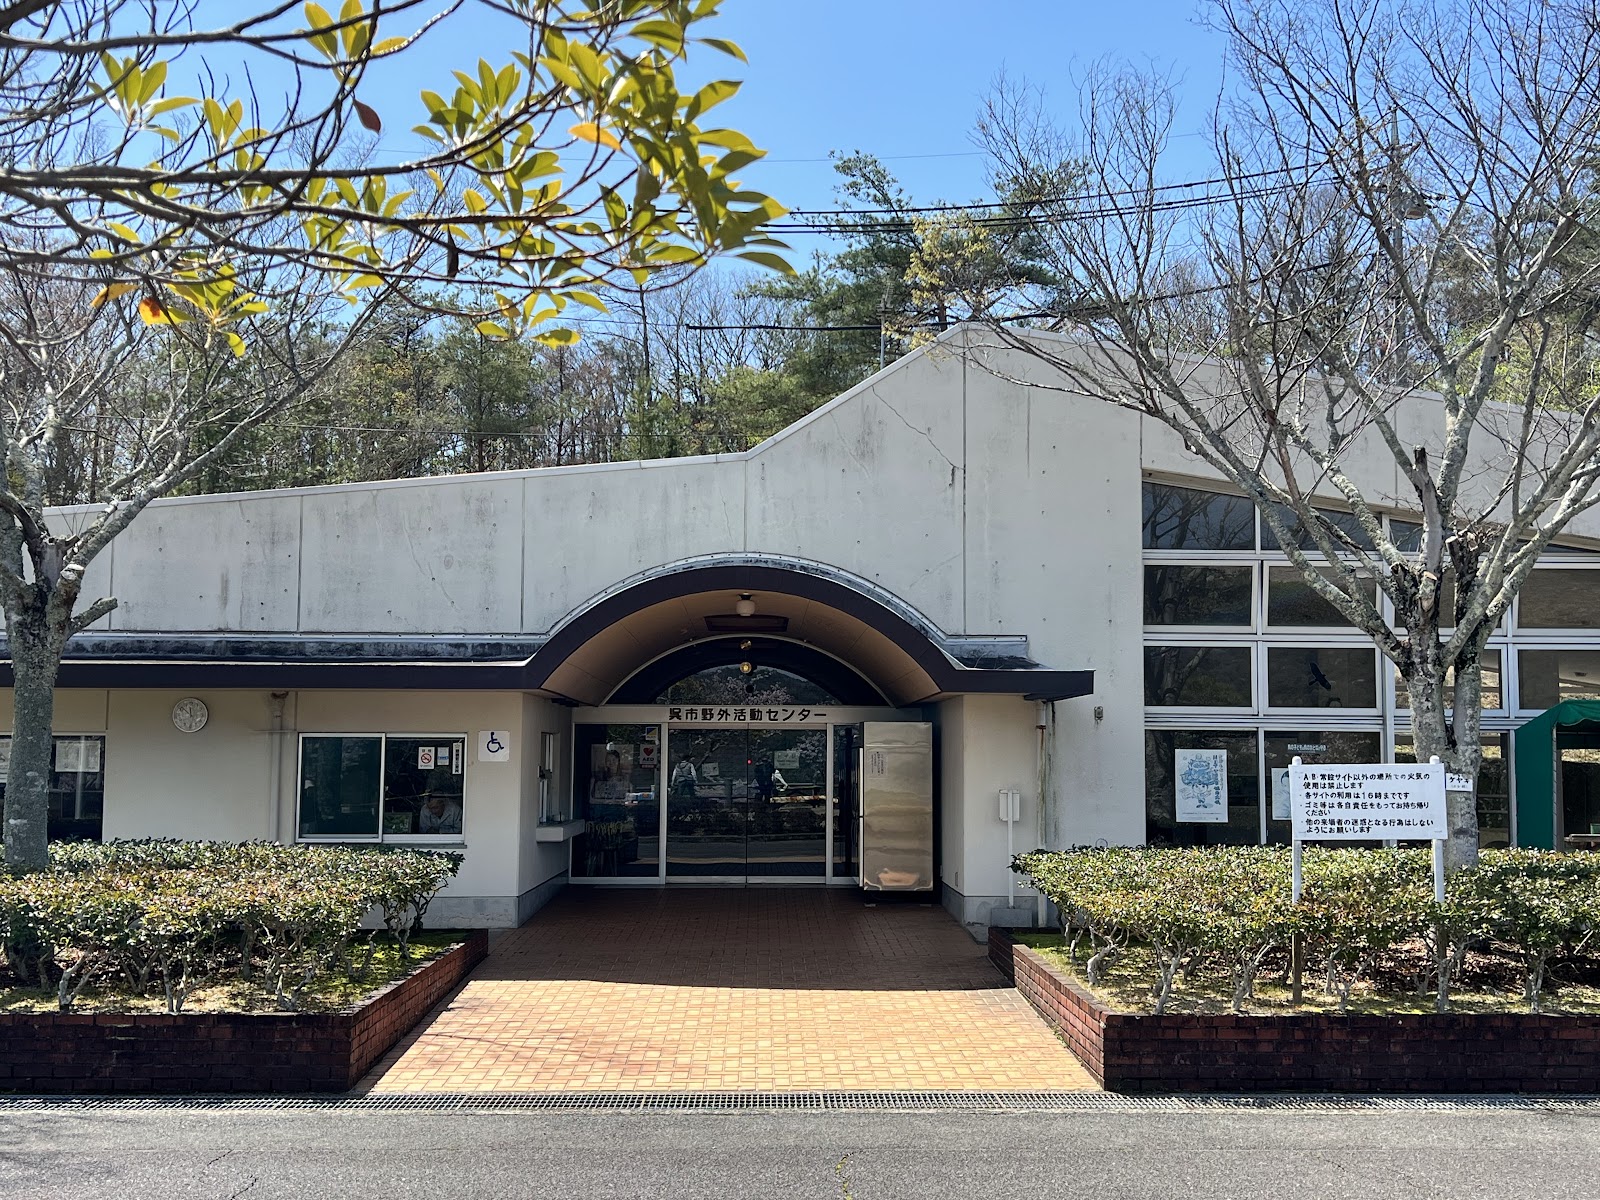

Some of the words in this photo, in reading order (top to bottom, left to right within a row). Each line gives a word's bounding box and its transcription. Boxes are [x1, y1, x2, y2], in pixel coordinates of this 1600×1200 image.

[669, 708, 827, 721] 呉市野外活動センター
[1303, 782, 1364, 790] 使用は禁止します
[1305, 809, 1331, 817] ください
[1306, 826, 1372, 834] ようにお願いします
